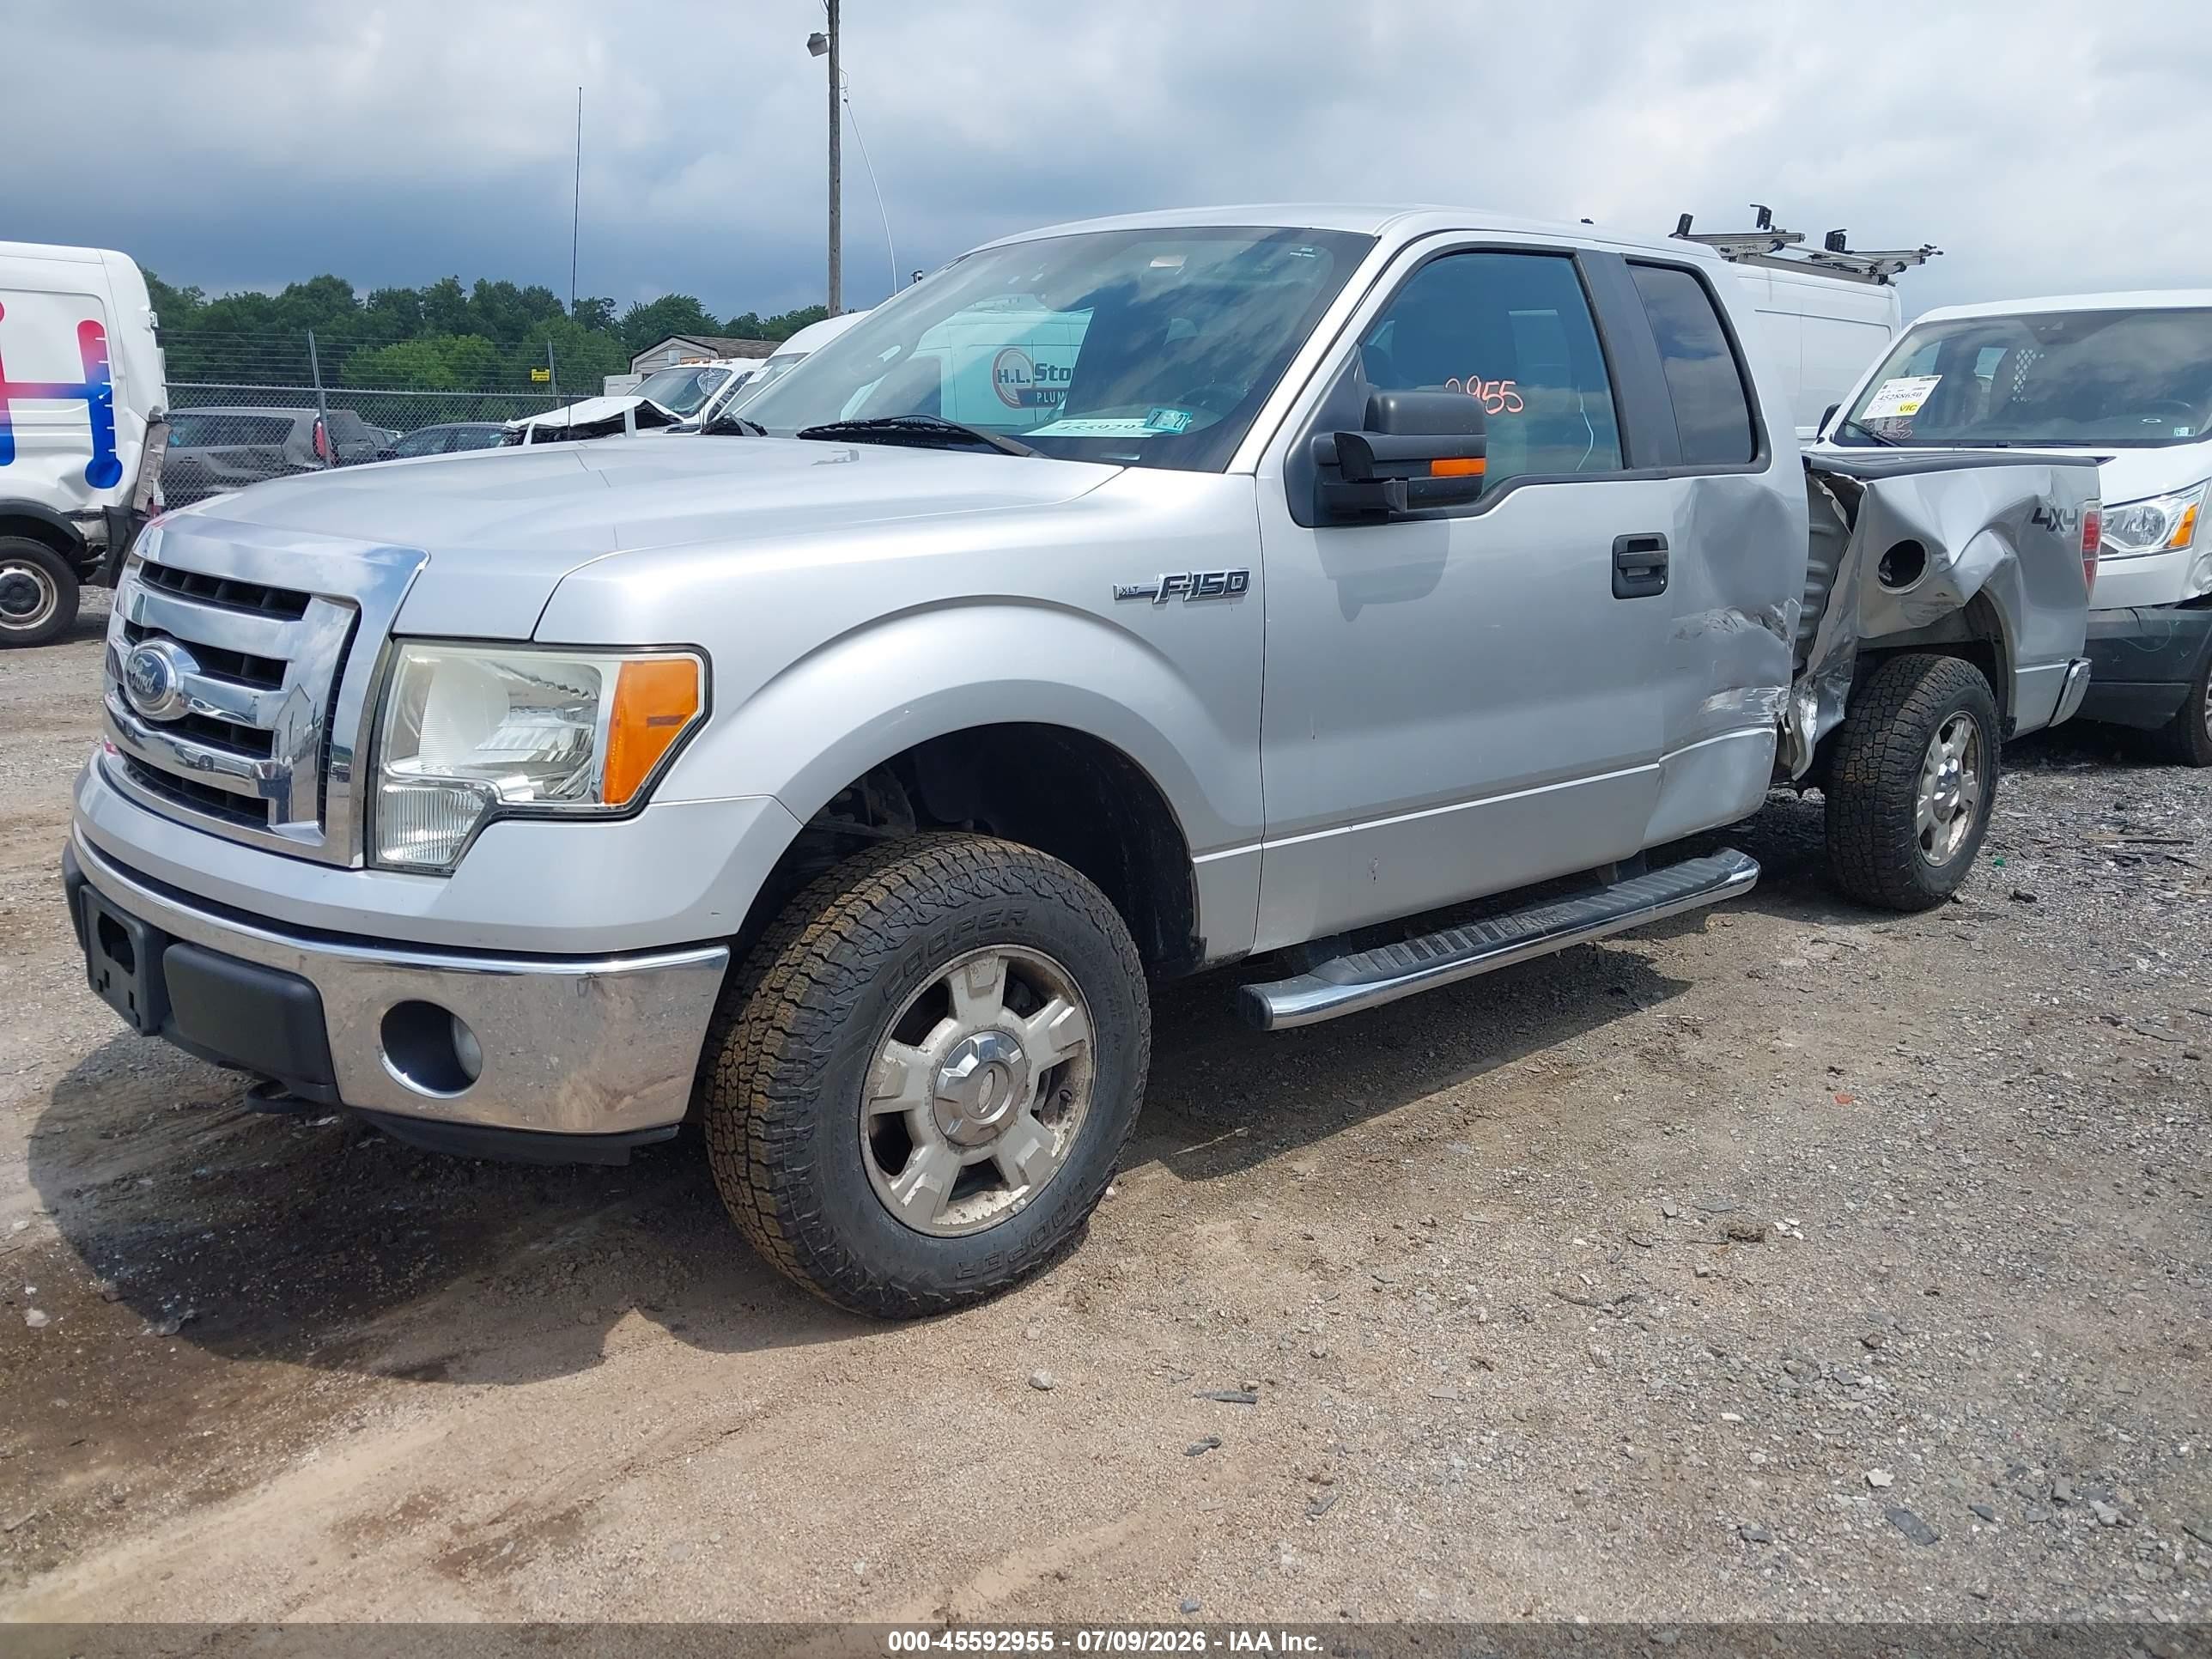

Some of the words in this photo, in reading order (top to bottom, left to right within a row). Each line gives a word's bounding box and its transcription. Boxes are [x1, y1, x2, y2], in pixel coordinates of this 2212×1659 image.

[997, 368, 1030, 384] H.L.
[1149, 411, 1163, 426] 7
[1173, 414, 1189, 430] 27
[1121, 586, 1139, 595] XLT
[127, 656, 158, 694] Ford
[883, 907, 1029, 1001] COOPER
